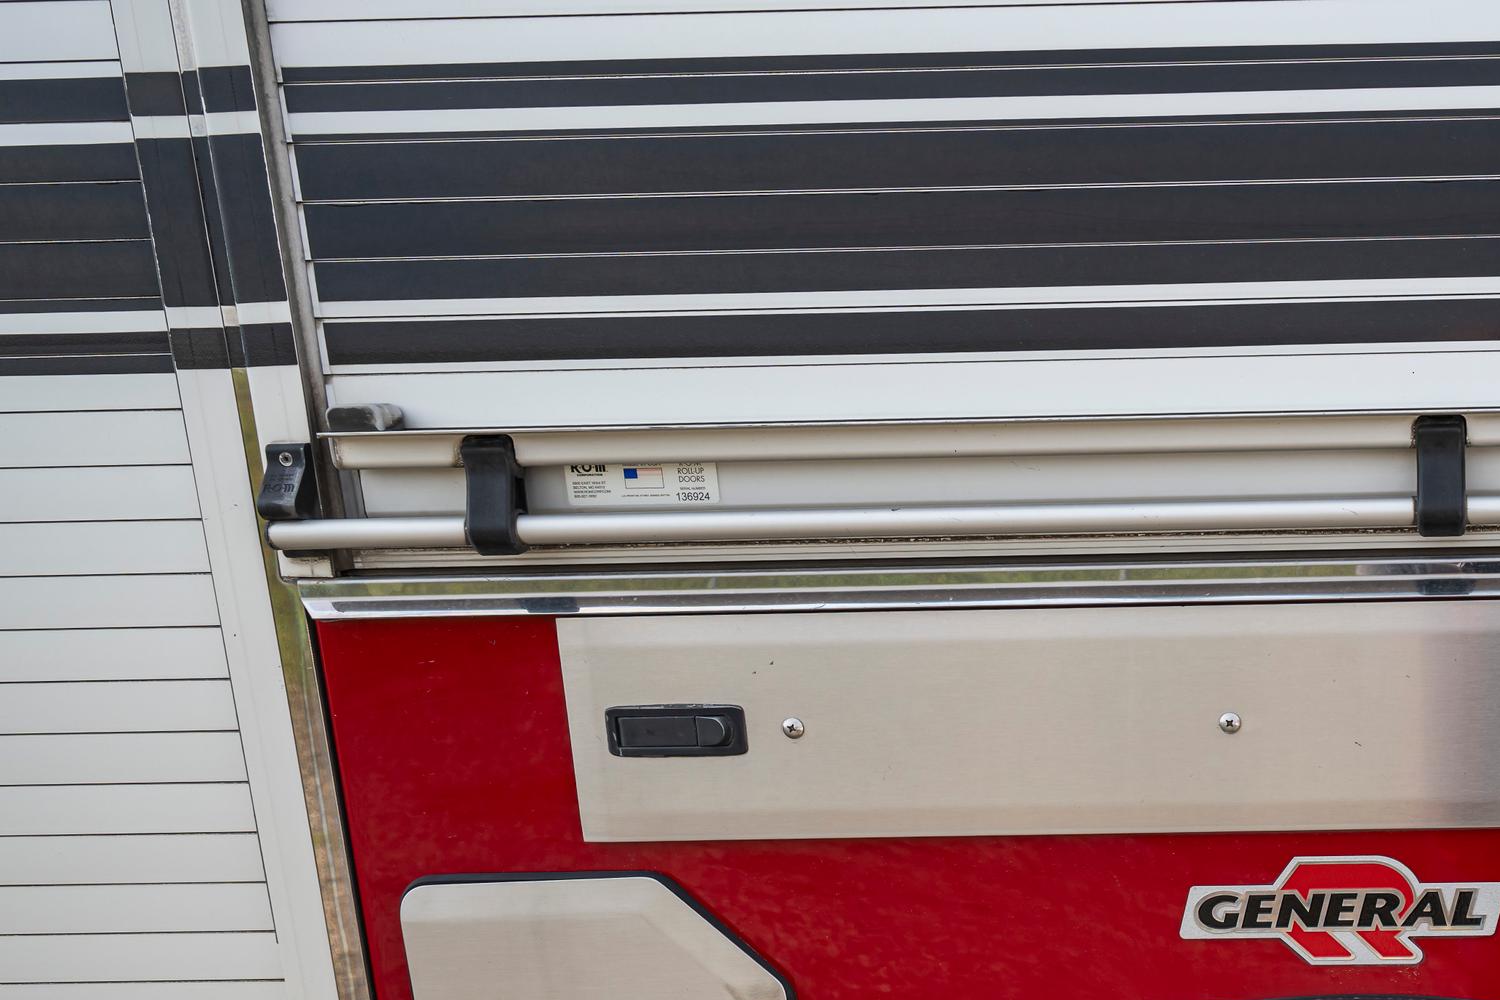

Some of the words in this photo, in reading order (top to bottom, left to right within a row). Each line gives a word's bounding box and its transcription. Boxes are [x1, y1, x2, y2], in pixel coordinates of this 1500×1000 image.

[678, 475, 705, 483] DOORS
[676, 492, 710, 501] 136924
[1195, 887, 1490, 930] GENERAL
